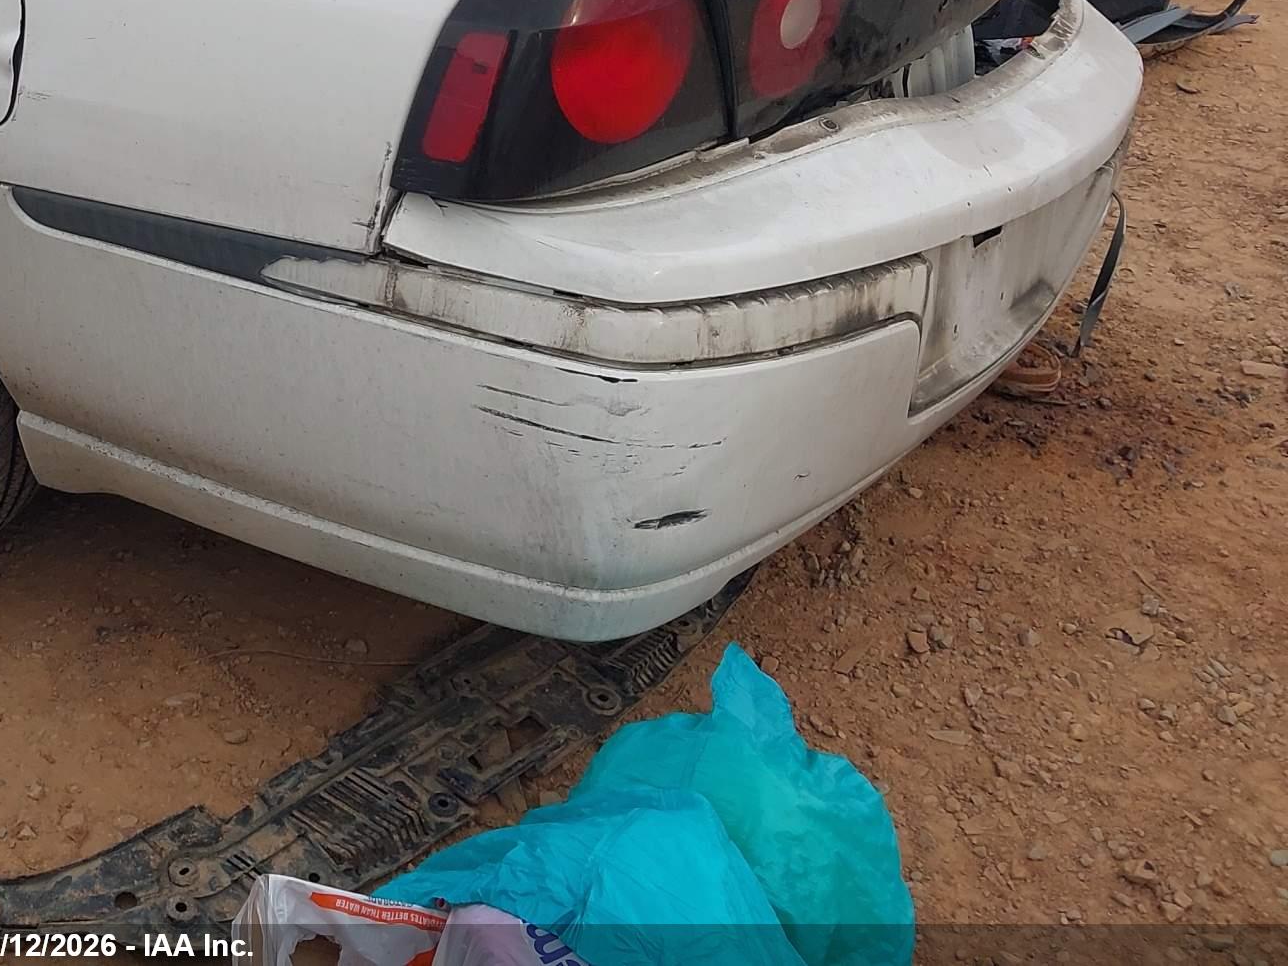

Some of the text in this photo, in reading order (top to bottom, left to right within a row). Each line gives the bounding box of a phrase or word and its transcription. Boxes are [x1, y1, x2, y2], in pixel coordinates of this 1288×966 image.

[335, 898, 360, 915] WATER
[361, 905, 380, 918] THAN
[381, 910, 409, 922] BETTER
